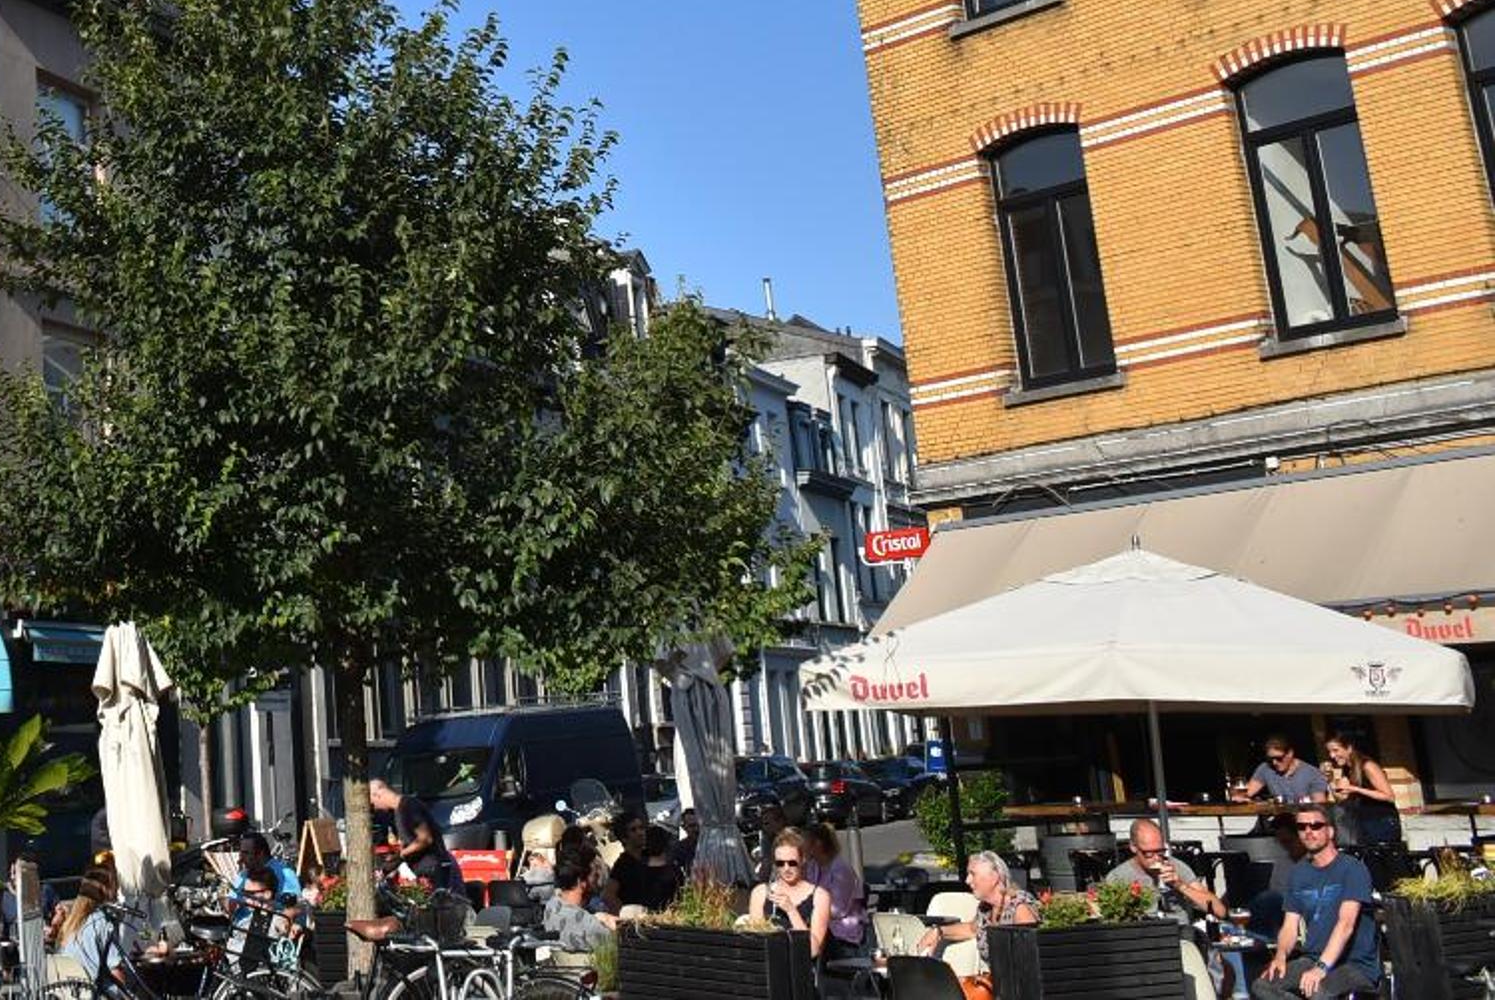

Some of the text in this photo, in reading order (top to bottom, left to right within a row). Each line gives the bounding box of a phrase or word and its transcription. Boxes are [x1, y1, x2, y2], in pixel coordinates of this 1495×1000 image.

[872, 533, 922, 556] Cristal
[1405, 614, 1474, 639] Duvel
[849, 672, 929, 702] Duvel
